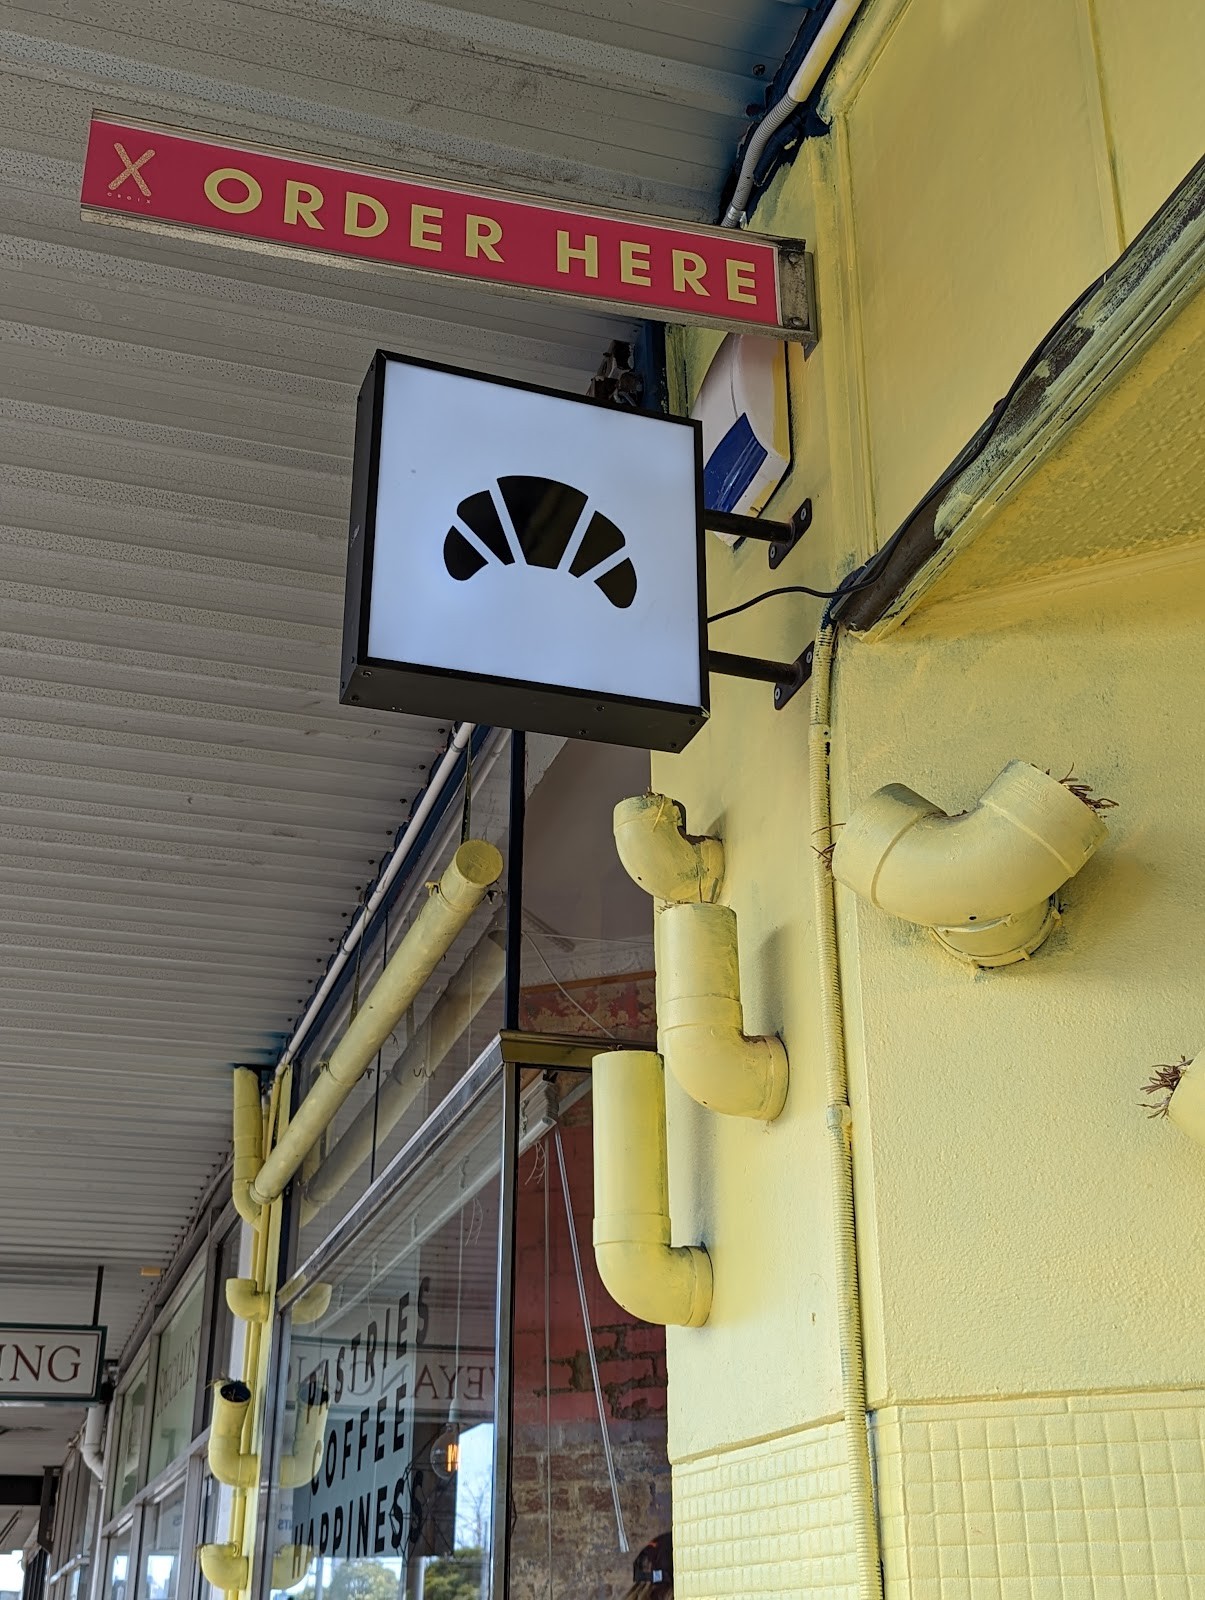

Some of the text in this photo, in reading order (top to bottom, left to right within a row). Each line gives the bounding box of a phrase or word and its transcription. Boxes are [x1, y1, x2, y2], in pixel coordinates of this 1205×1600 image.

[203, 166, 758, 306] ORDER HERE
[306, 1276, 431, 1424] PASTRIES
[310, 1382, 407, 1496] COFFEE
[290, 1469, 424, 1580] HAPPINESS
